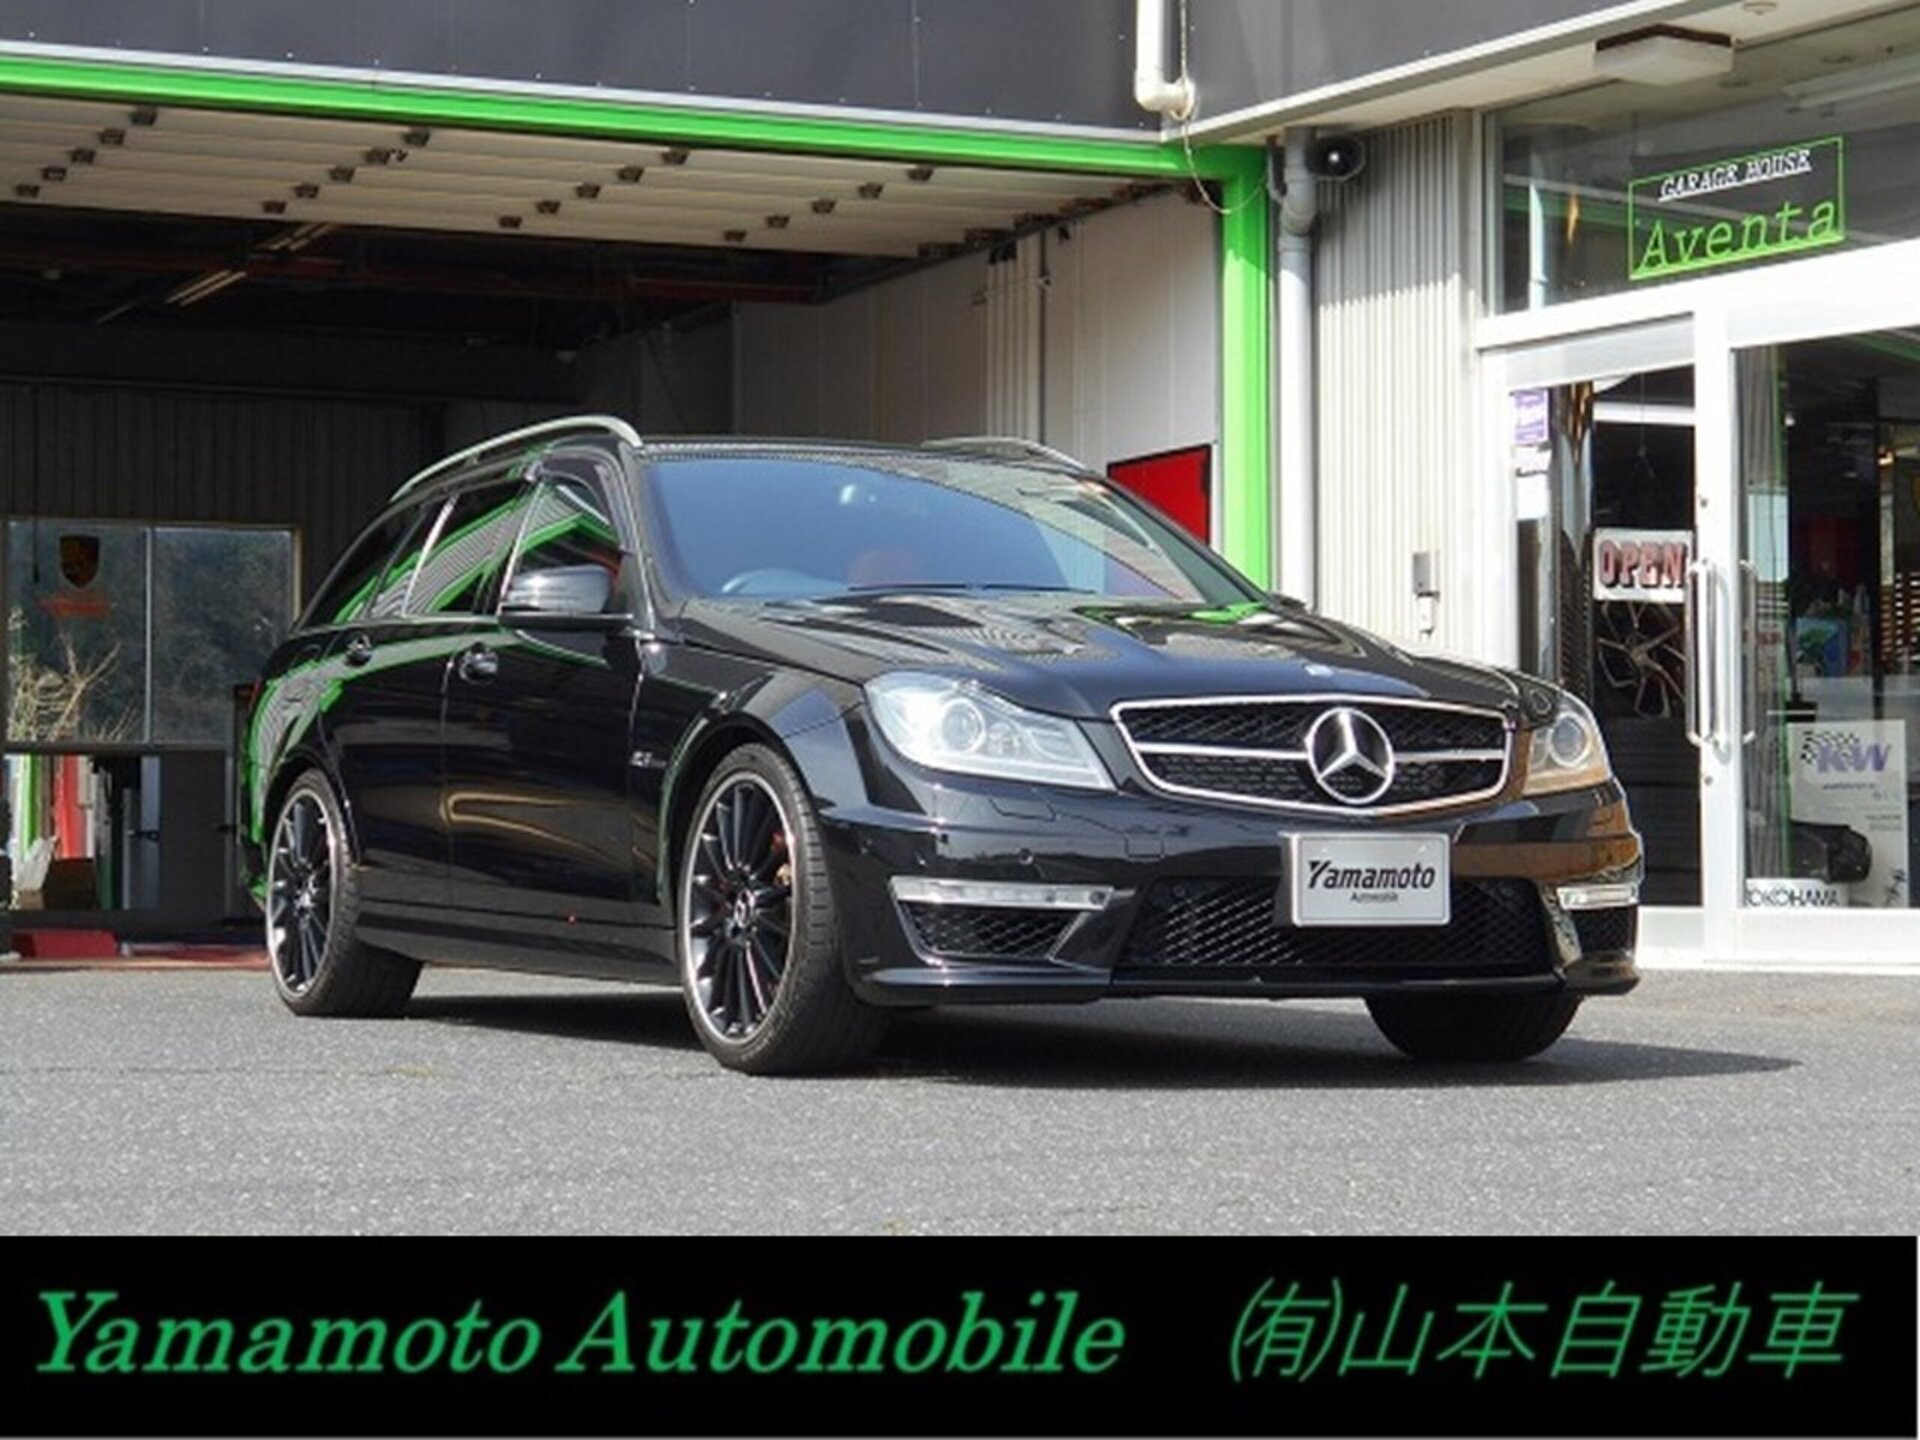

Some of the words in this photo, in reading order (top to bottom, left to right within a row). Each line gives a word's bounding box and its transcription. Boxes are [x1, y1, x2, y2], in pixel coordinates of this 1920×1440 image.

[1660, 163, 1738, 198] GARAGE
[1745, 149, 1811, 185] HOUSE
[1636, 201, 1836, 275] Aventa
[1599, 538, 1687, 588] OPEN
[1308, 860, 1435, 889] Yamamoto
